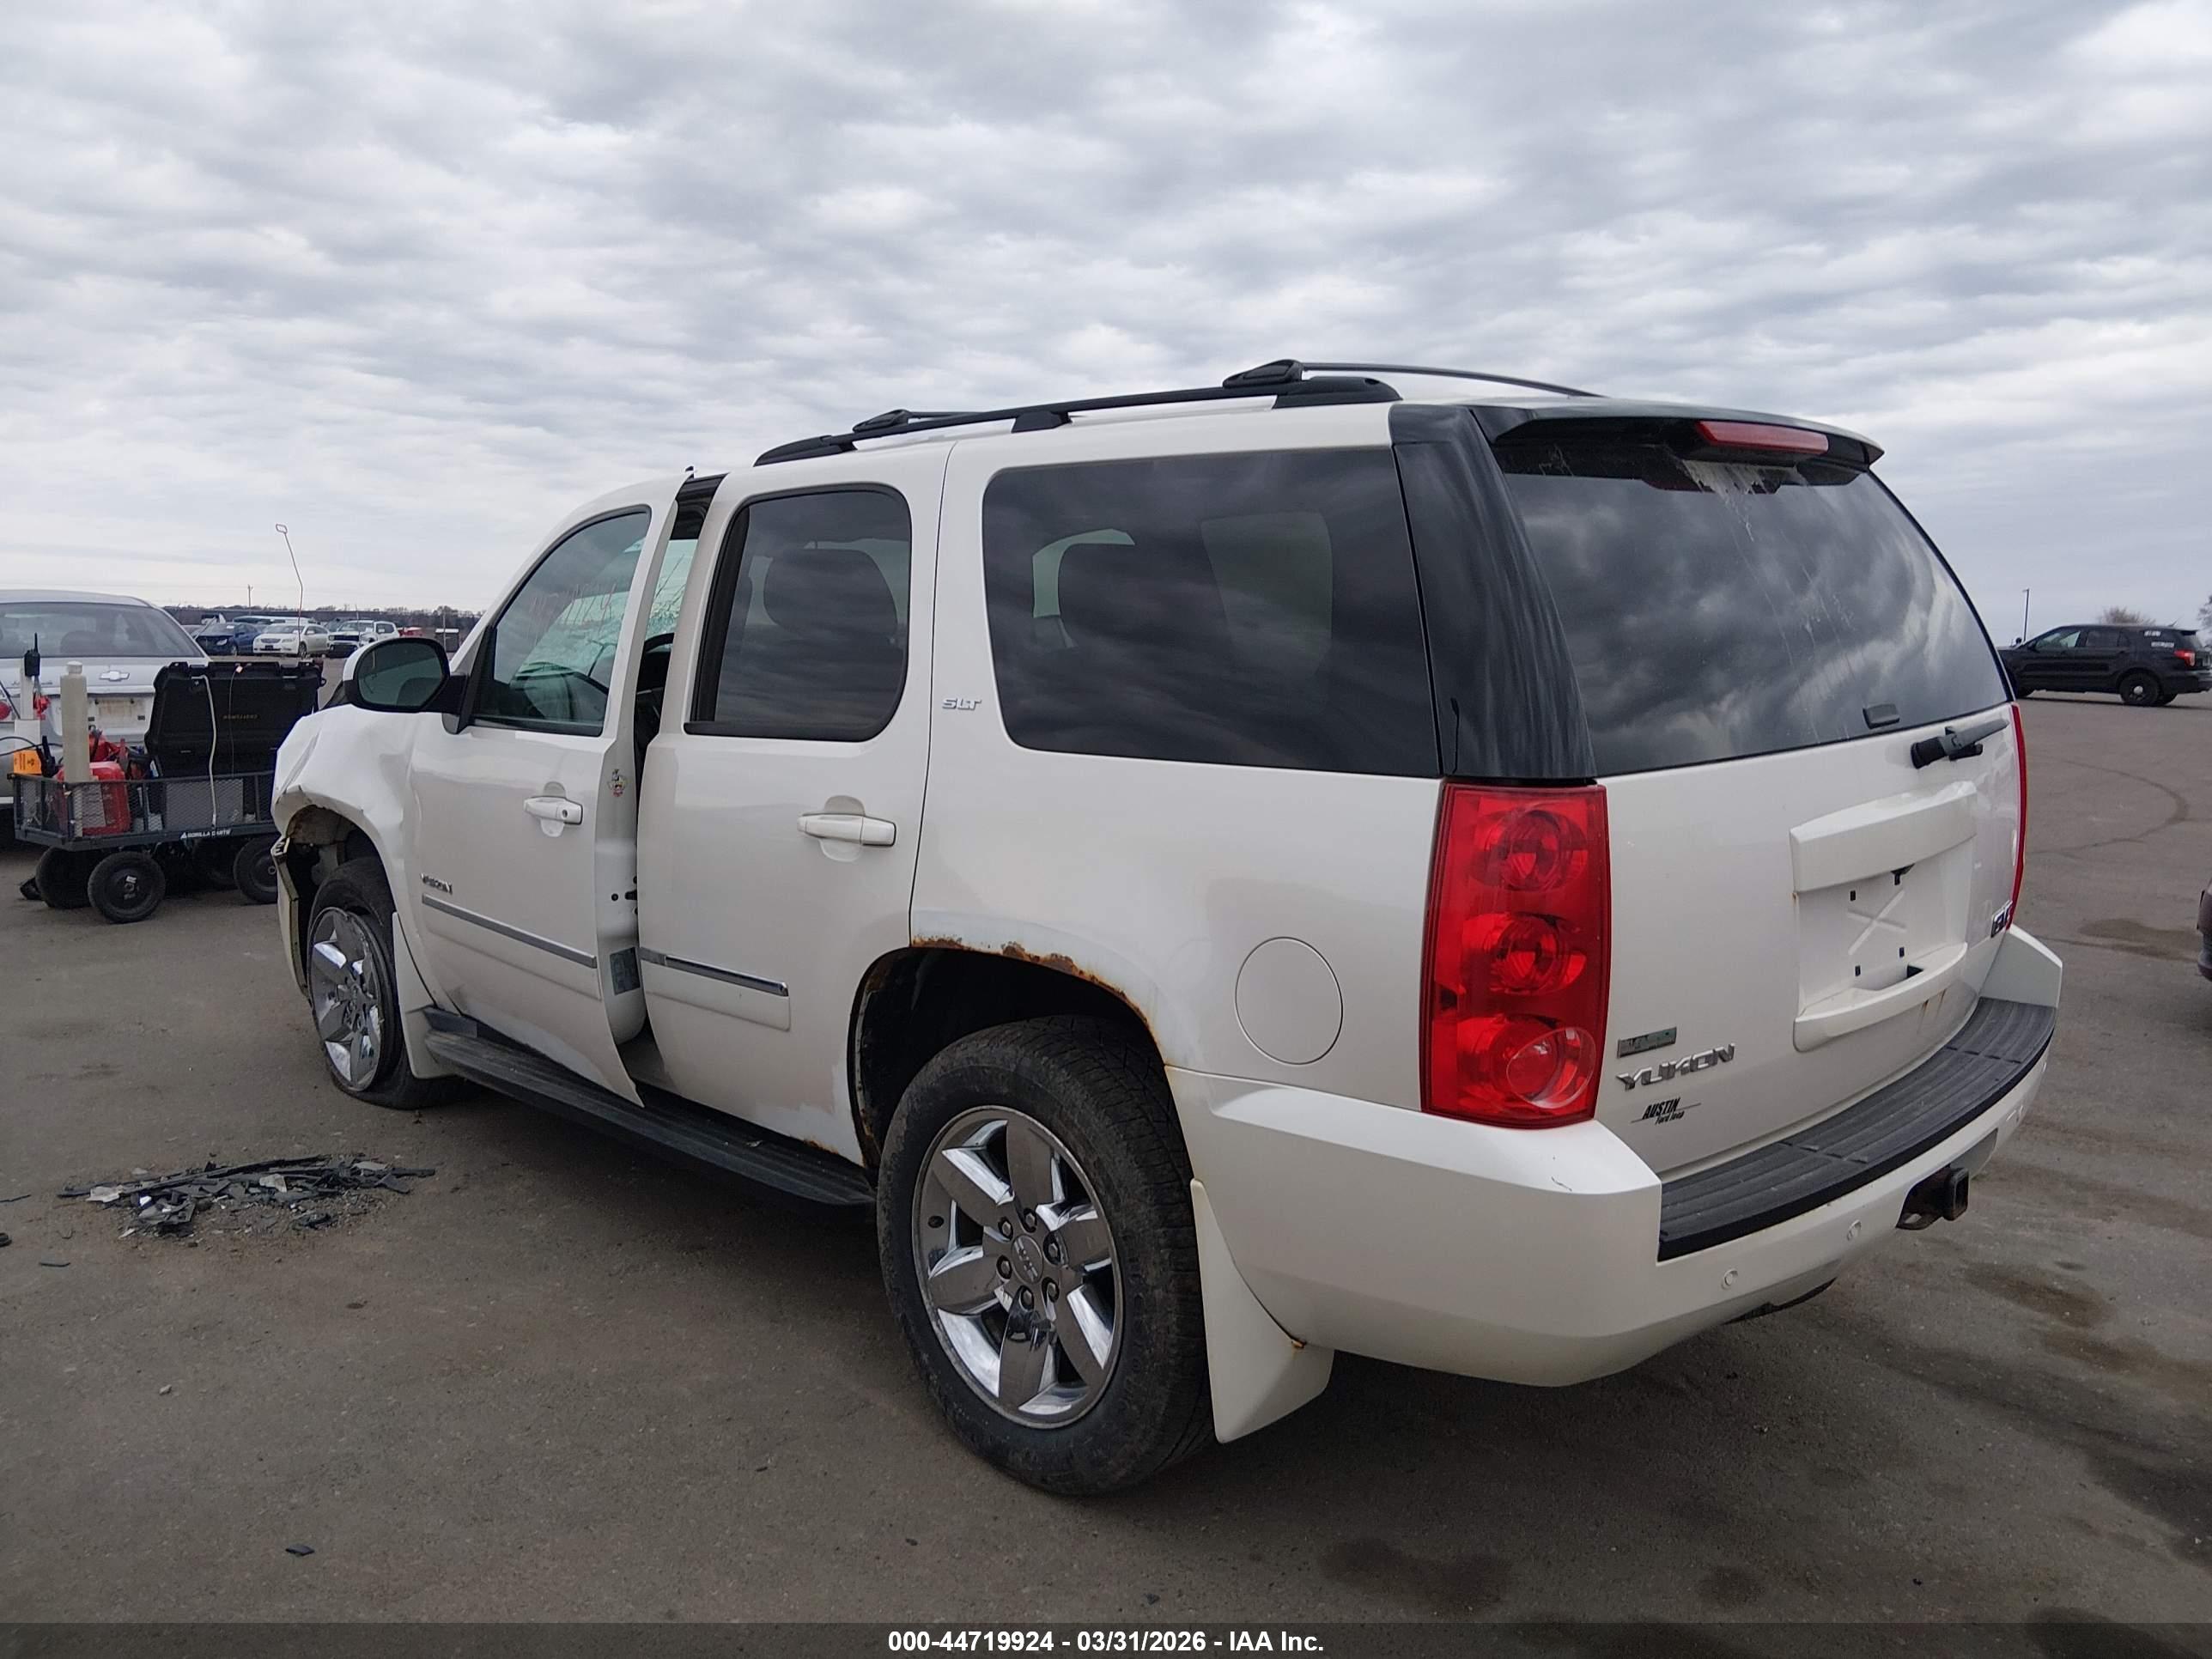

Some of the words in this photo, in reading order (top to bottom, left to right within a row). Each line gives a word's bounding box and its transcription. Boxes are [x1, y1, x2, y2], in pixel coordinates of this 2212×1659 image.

[942, 697, 981, 710] SLT
[1616, 1042, 1735, 1091] YUKON
[1642, 1097, 1681, 1120] AUSTIN
